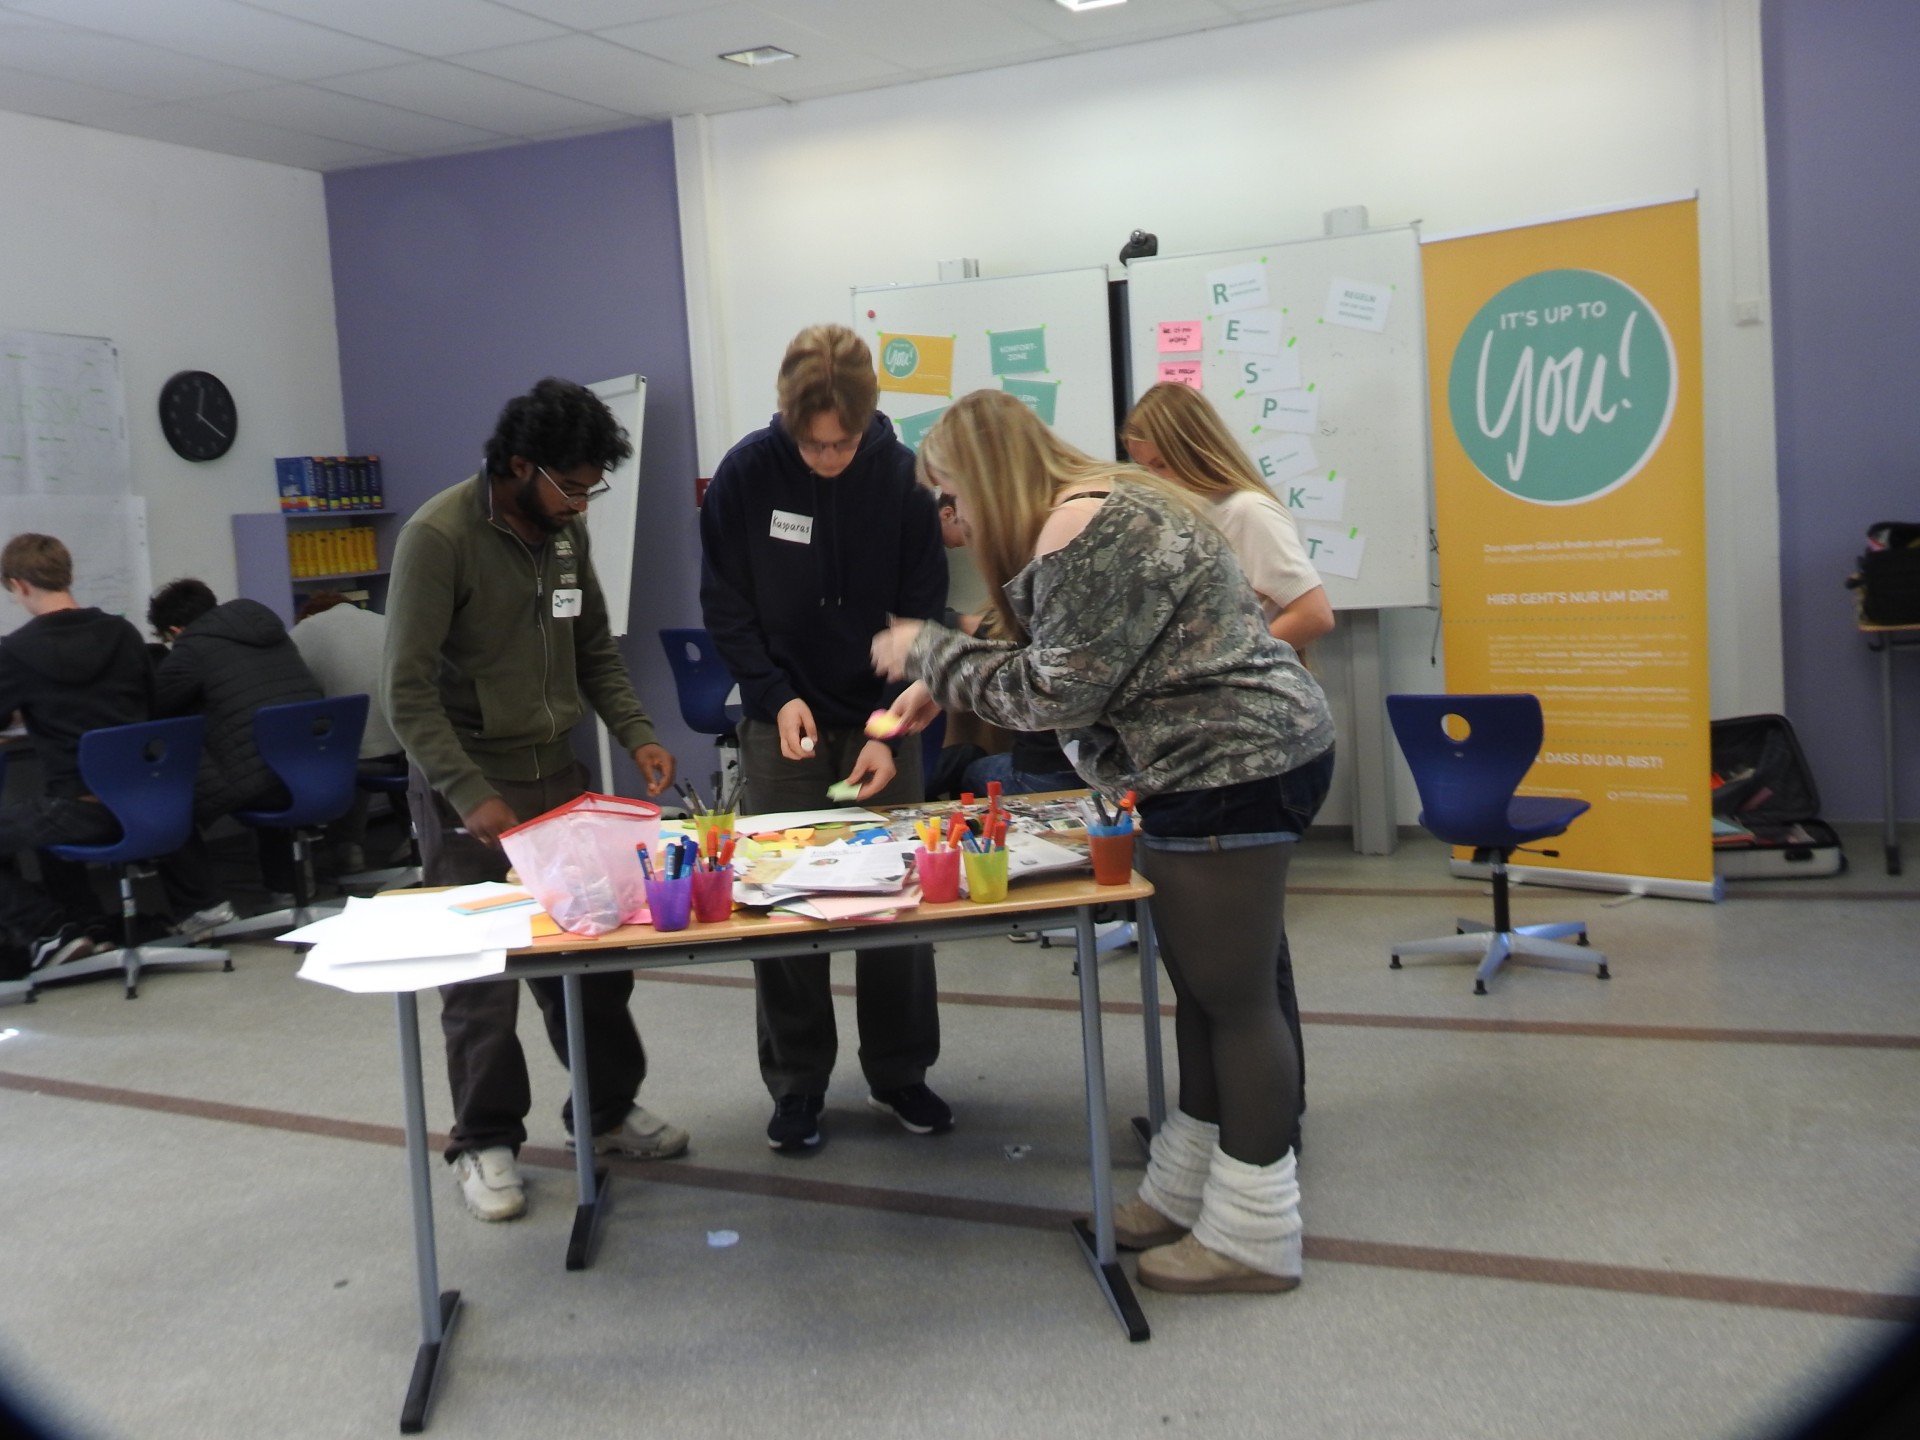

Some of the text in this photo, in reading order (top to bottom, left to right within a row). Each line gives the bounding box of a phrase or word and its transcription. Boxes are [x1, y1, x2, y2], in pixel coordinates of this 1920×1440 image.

[1213, 283, 1229, 305] R
[1500, 301, 1607, 330] IT'S UP TO
[1226, 319, 1241, 341] E
[999, 342, 1037, 353] KOMFORT-
[1007, 352, 1029, 361] ZONE
[1244, 362, 1259, 384] S
[1476, 311, 1638, 482] you!
[1262, 397, 1278, 419] P
[1258, 455, 1277, 478] E
[1289, 486, 1307, 509] K
[1306, 538, 1323, 560] T
[1486, 588, 1669, 605] HIER GEHT'S NUR UM DICH!
[1545, 752, 1581, 765] DASS
[1582, 754, 1602, 767] DU
[1606, 755, 1626, 768] DA
[1627, 755, 1664, 769] BIST!
